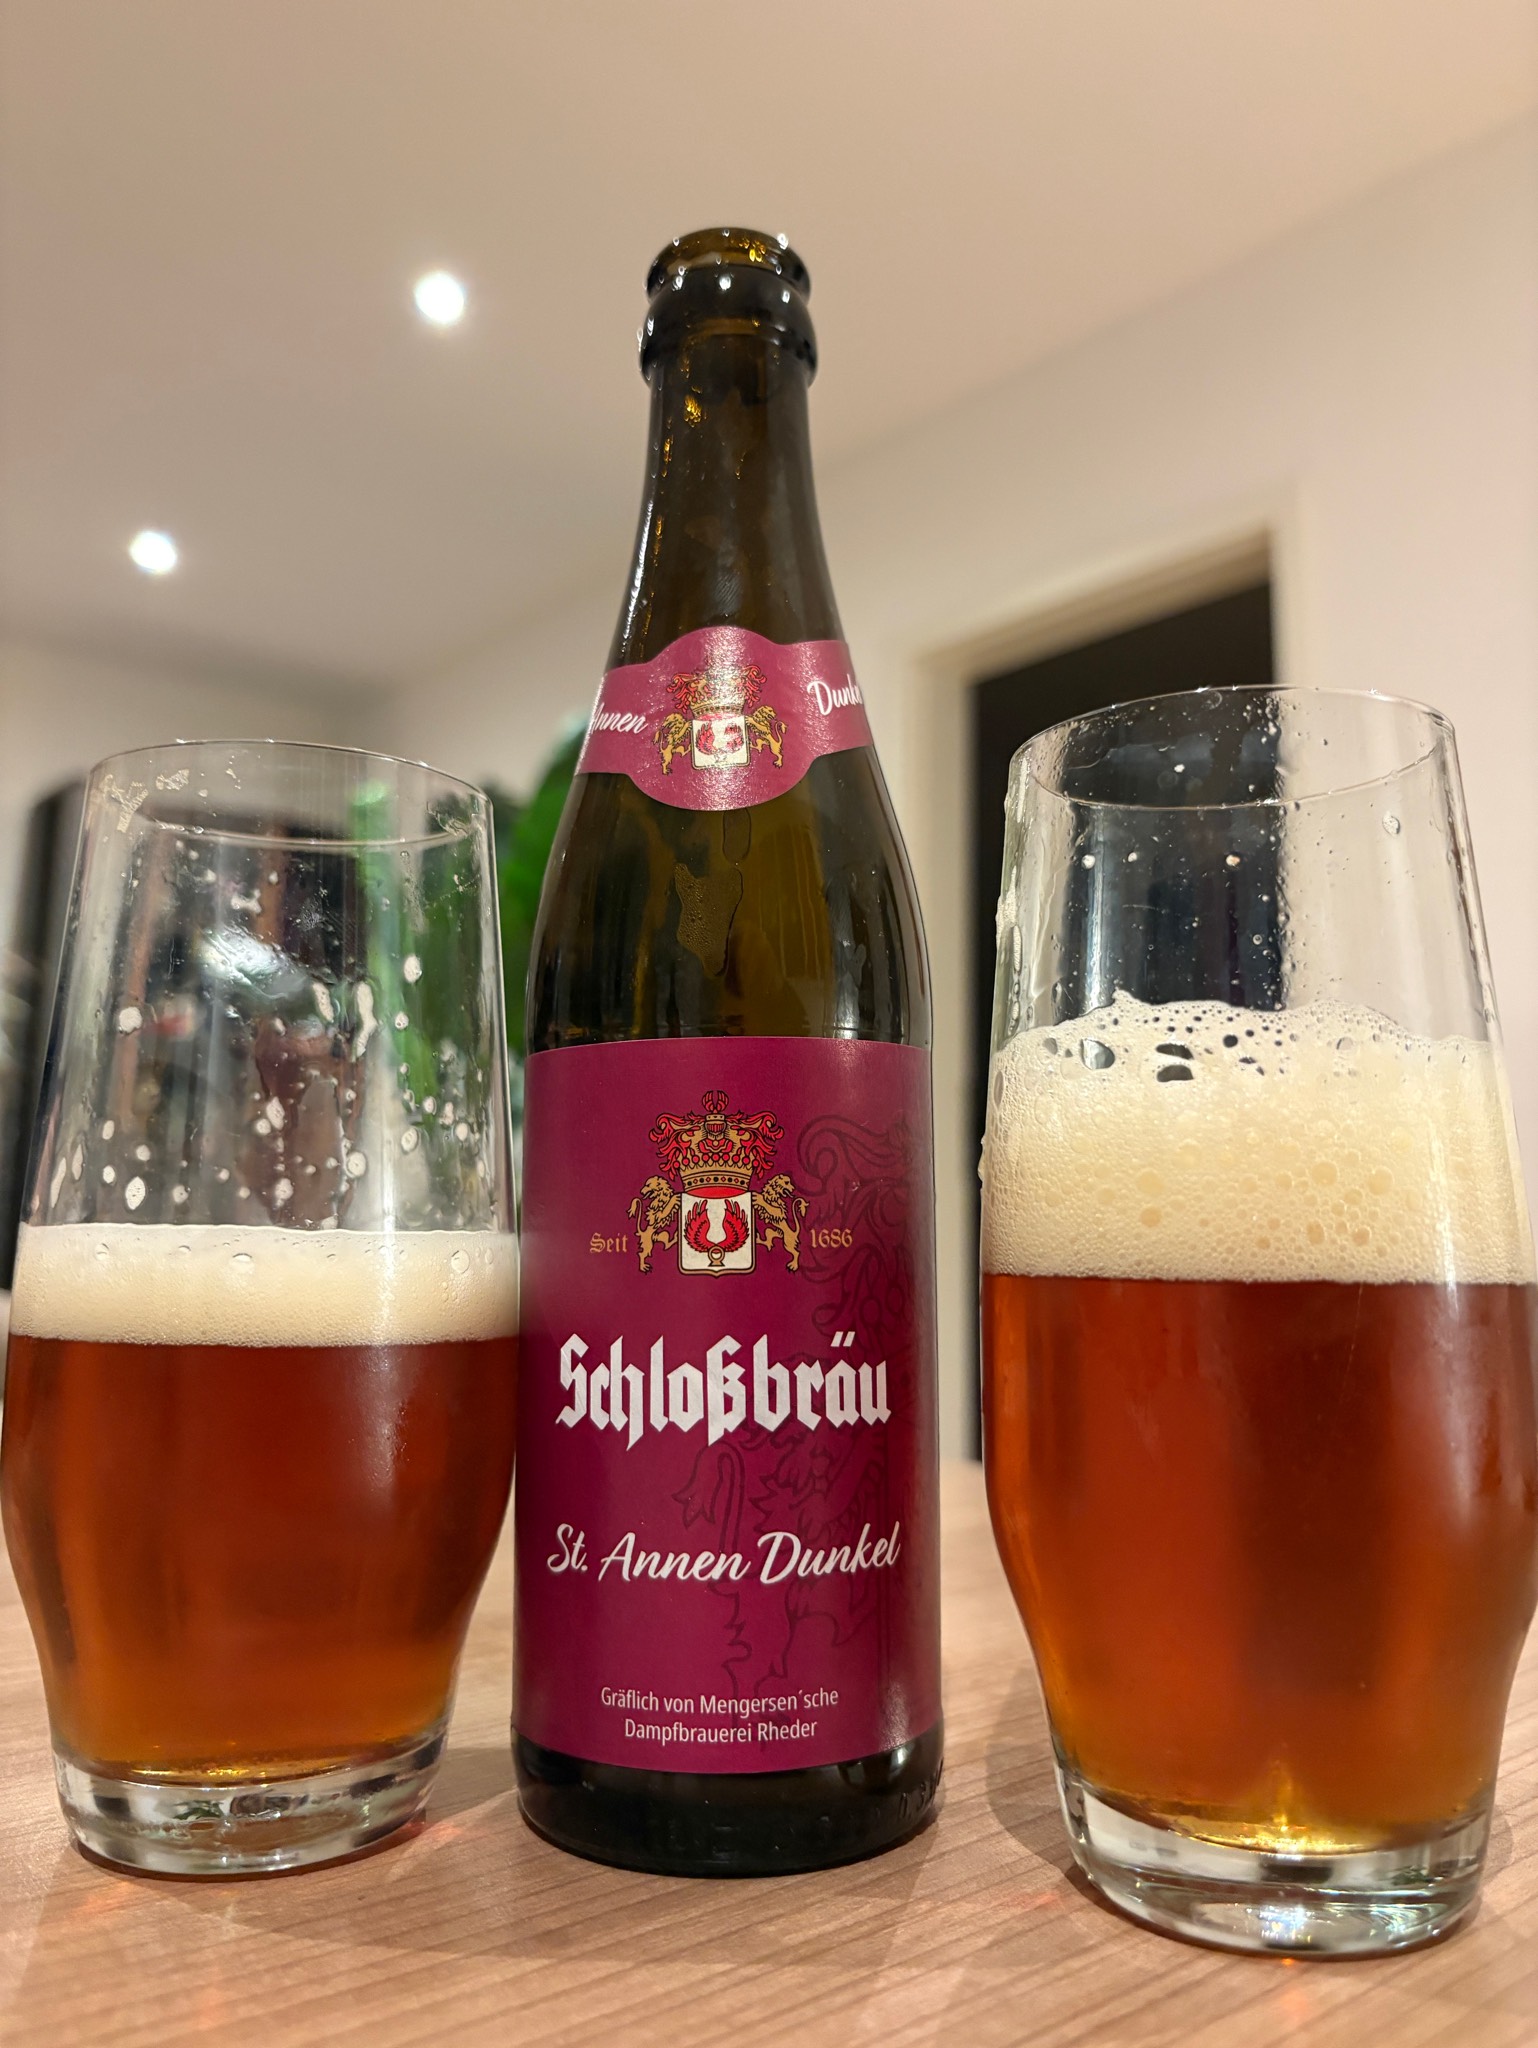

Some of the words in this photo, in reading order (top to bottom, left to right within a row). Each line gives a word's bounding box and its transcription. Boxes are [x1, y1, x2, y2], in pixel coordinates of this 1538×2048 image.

[588, 1232, 629, 1254] Seit
[810, 1228, 853, 1249] 1686
[555, 1331, 892, 1452] Schloßbräu
[546, 1522, 588, 1573] St.
[598, 1531, 751, 1583] Annen
[757, 1520, 901, 1584] Dunkel
[600, 1686, 659, 1712] Gräflich
[663, 1695, 695, 1714] von
[624, 1718, 752, 1747] Dampfbrauerei
[757, 1720, 818, 1742] Rheder
